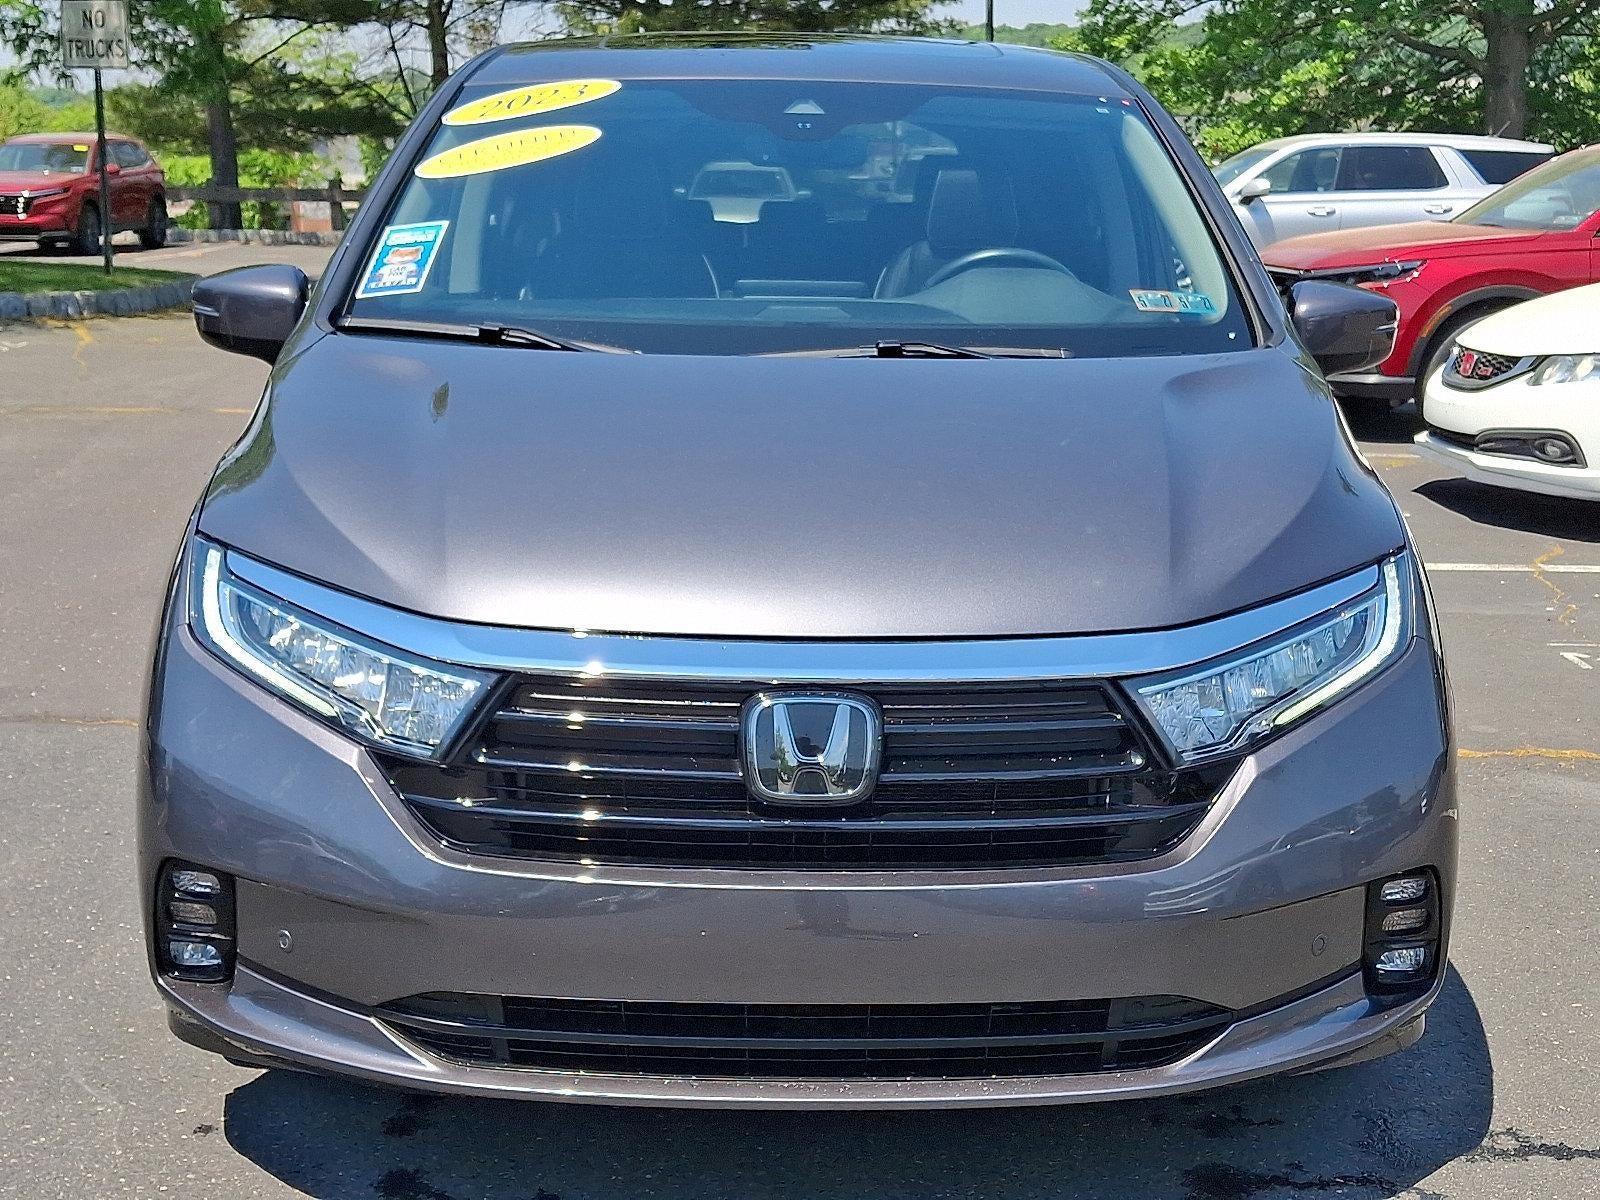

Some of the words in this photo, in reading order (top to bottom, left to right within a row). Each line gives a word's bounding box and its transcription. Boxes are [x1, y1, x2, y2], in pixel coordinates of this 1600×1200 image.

[82, 9, 106, 29] NO
[67, 38, 125, 59] TRUCKS
[479, 84, 590, 118] 2023
